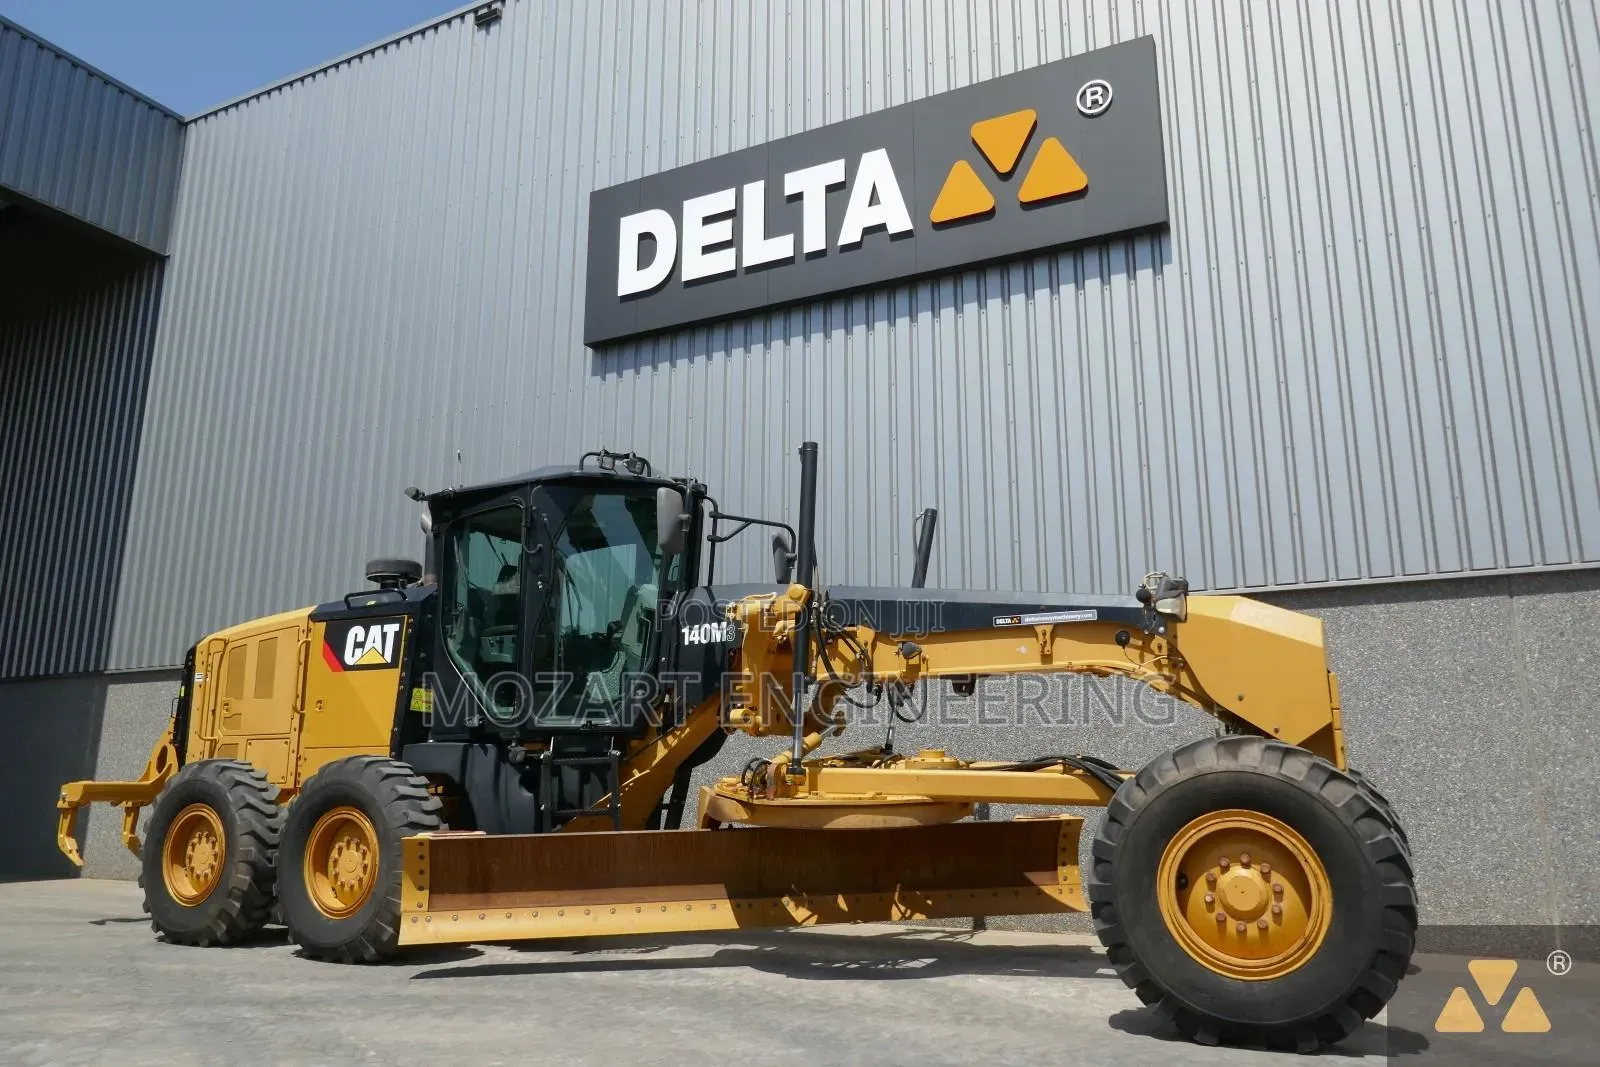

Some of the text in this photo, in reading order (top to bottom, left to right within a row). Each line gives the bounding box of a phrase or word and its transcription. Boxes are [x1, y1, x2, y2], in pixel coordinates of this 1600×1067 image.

[617, 148, 914, 297] DELTA
[995, 617, 1011, 625] DELTA
[344, 623, 400, 666] CAT
